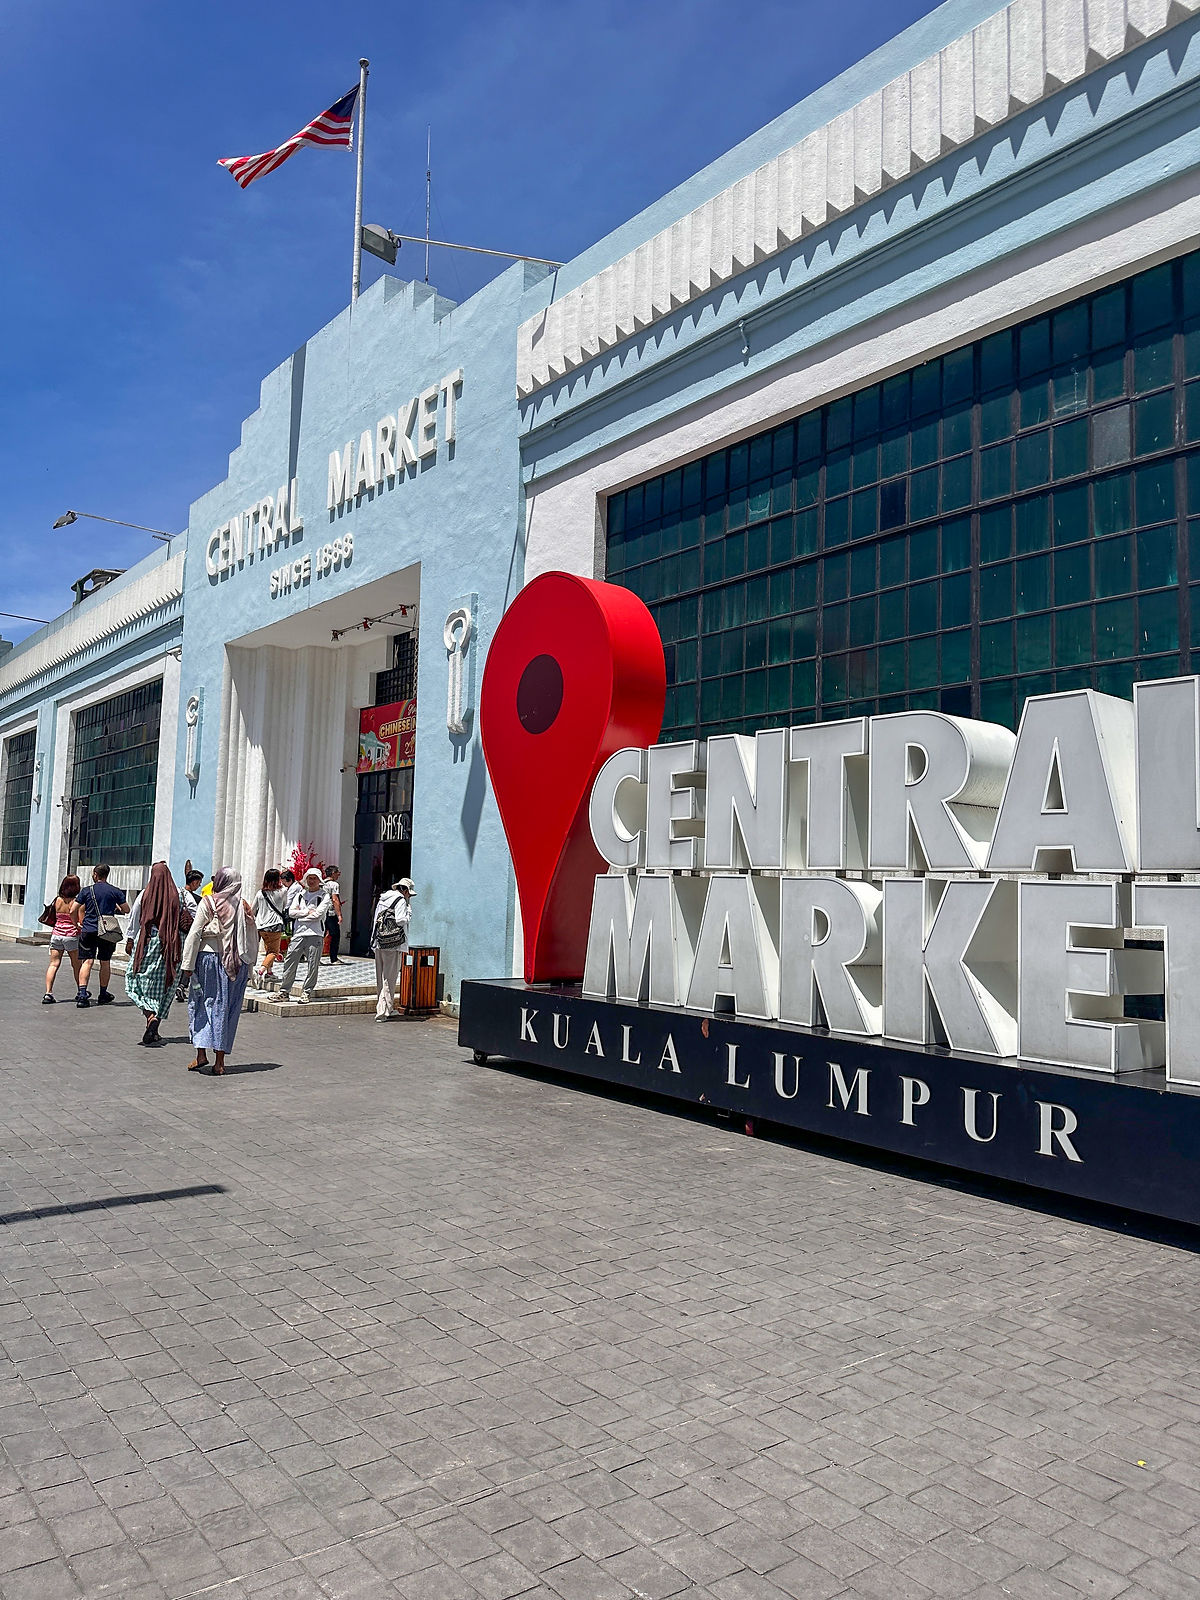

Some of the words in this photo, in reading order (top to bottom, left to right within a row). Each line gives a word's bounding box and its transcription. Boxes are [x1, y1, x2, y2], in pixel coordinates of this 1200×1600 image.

[205, 477, 304, 577] CENTRAL
[327, 367, 464, 511] MARKET
[269, 553, 311, 594] SINCE
[315, 532, 353, 574] 1888
[380, 718, 411, 738] CHINESE
[589, 675, 1200, 874] CENTRAL
[519, 1006, 682, 1074] KUALA
[725, 1042, 1085, 1163] LUMPUR
